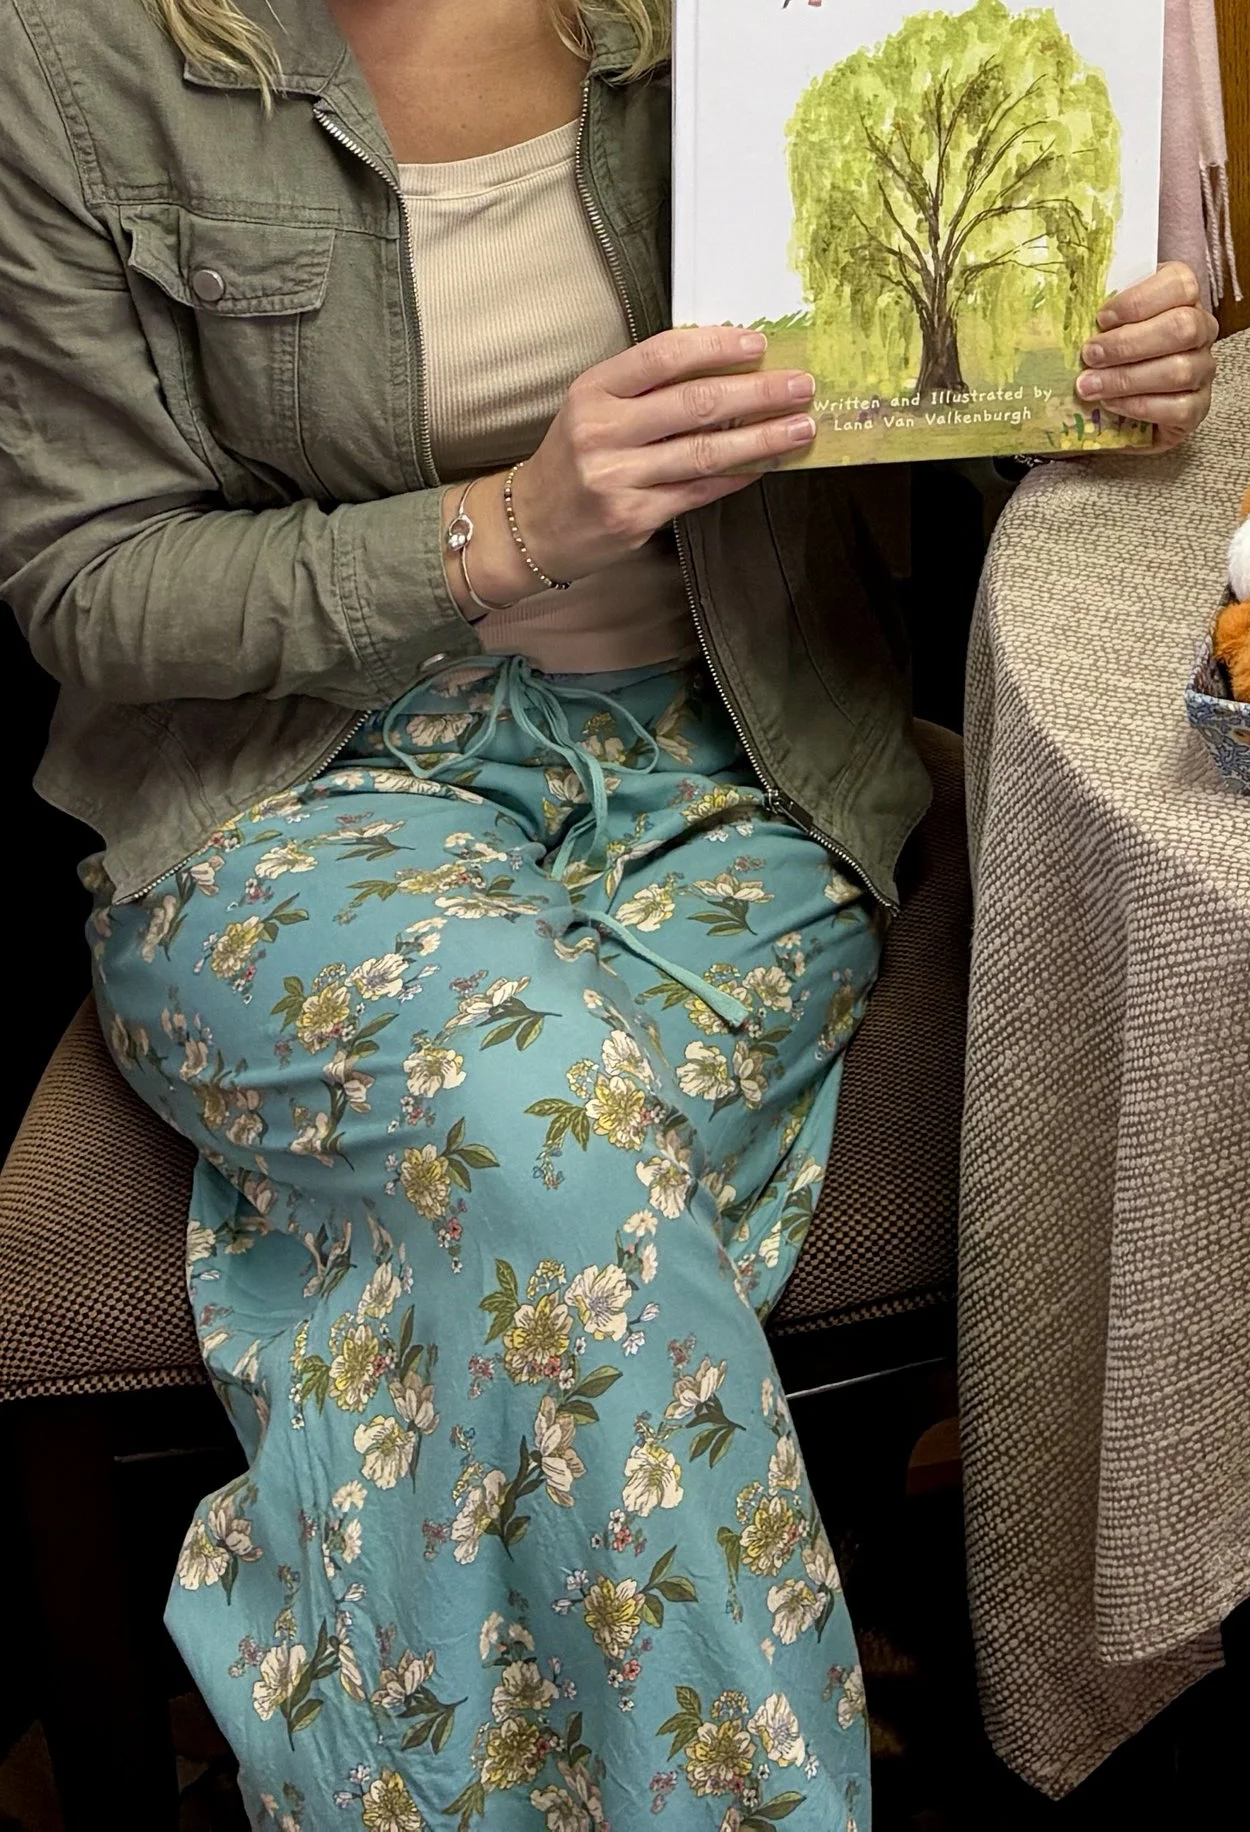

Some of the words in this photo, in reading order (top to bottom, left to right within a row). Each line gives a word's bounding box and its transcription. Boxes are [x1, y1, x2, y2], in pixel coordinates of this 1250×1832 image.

[813, 397, 880, 413] Written
[890, 392, 920, 407] and
[930, 386, 1024, 405] Illustrated
[1034, 386, 1053, 402] by
[834, 418, 873, 431] Lana
[884, 415, 914, 428] Van
[926, 407, 1032, 425] Valkenburgh
